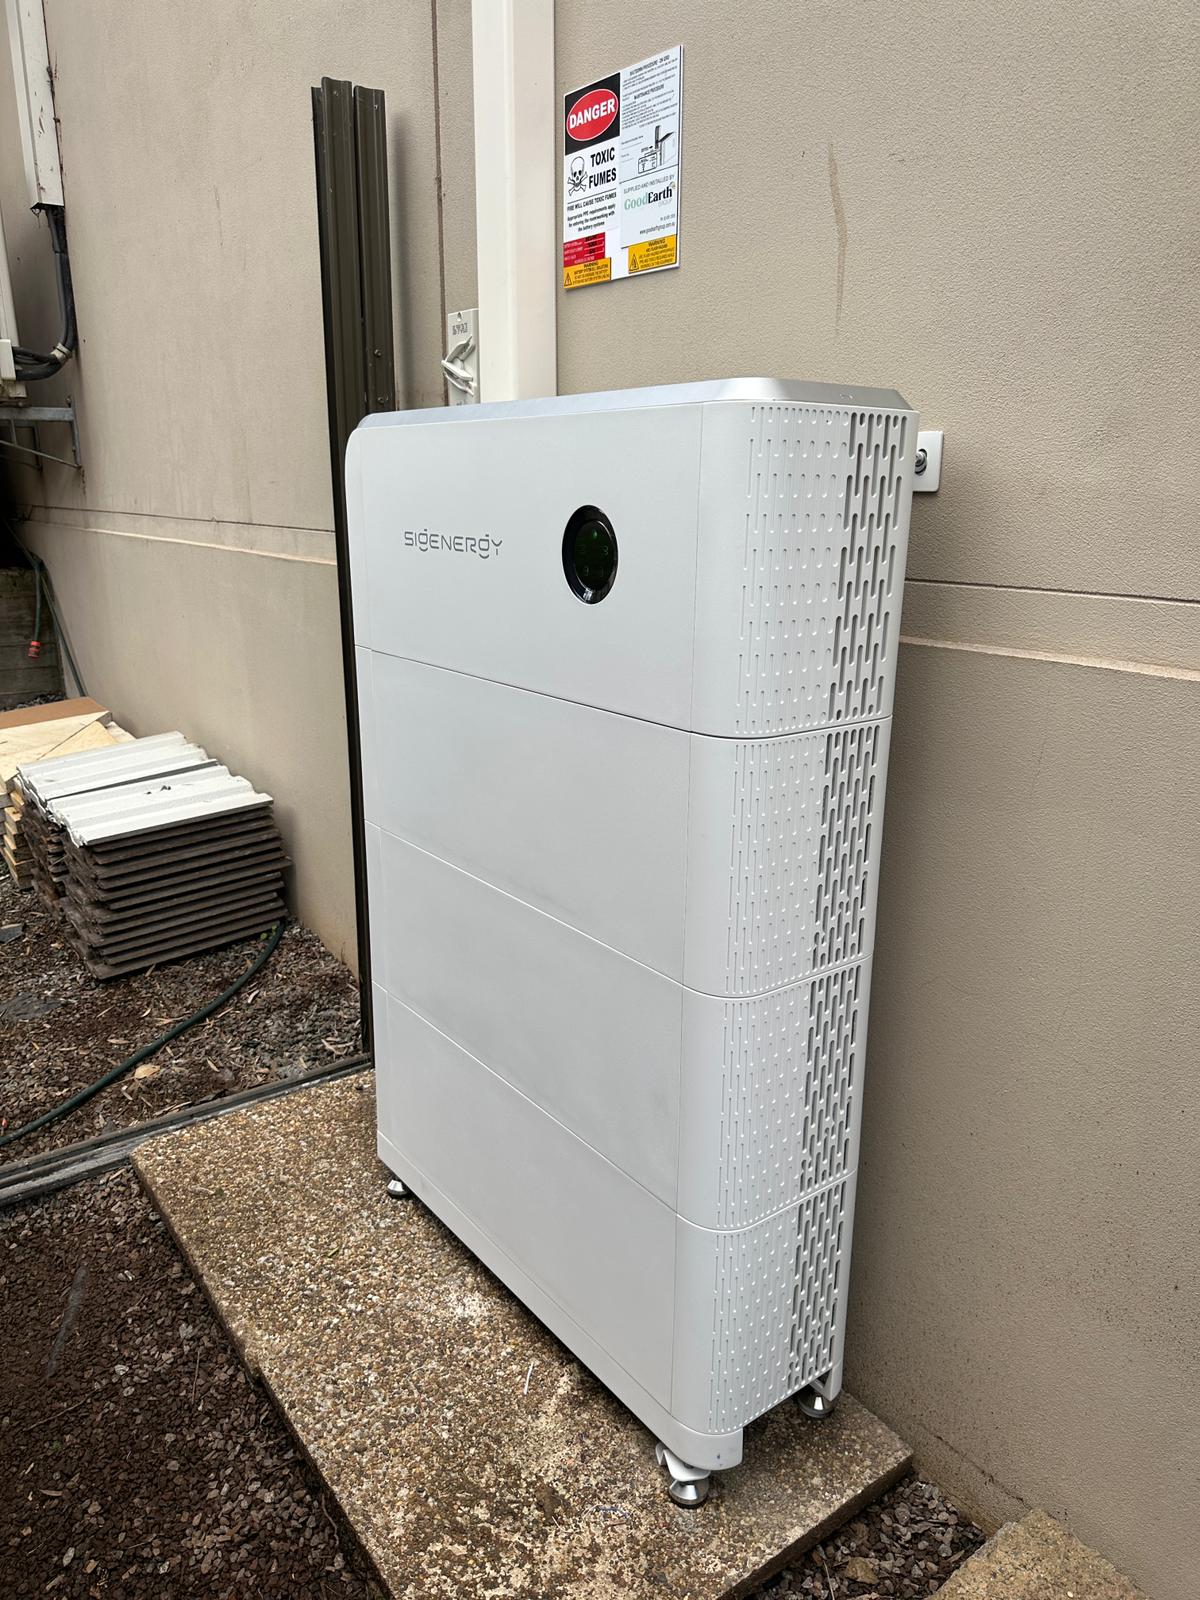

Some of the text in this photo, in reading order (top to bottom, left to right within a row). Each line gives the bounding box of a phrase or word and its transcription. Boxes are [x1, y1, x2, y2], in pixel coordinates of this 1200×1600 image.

[569, 98, 615, 129] DANGER
[590, 147, 615, 167] TOXIC
[588, 167, 617, 189] FUMES
[583, 199, 593, 207] CAUSE
[605, 192, 616, 200] FUMES
[624, 186, 673, 210] GoodEarth
[404, 528, 503, 559] SIGENERGY
